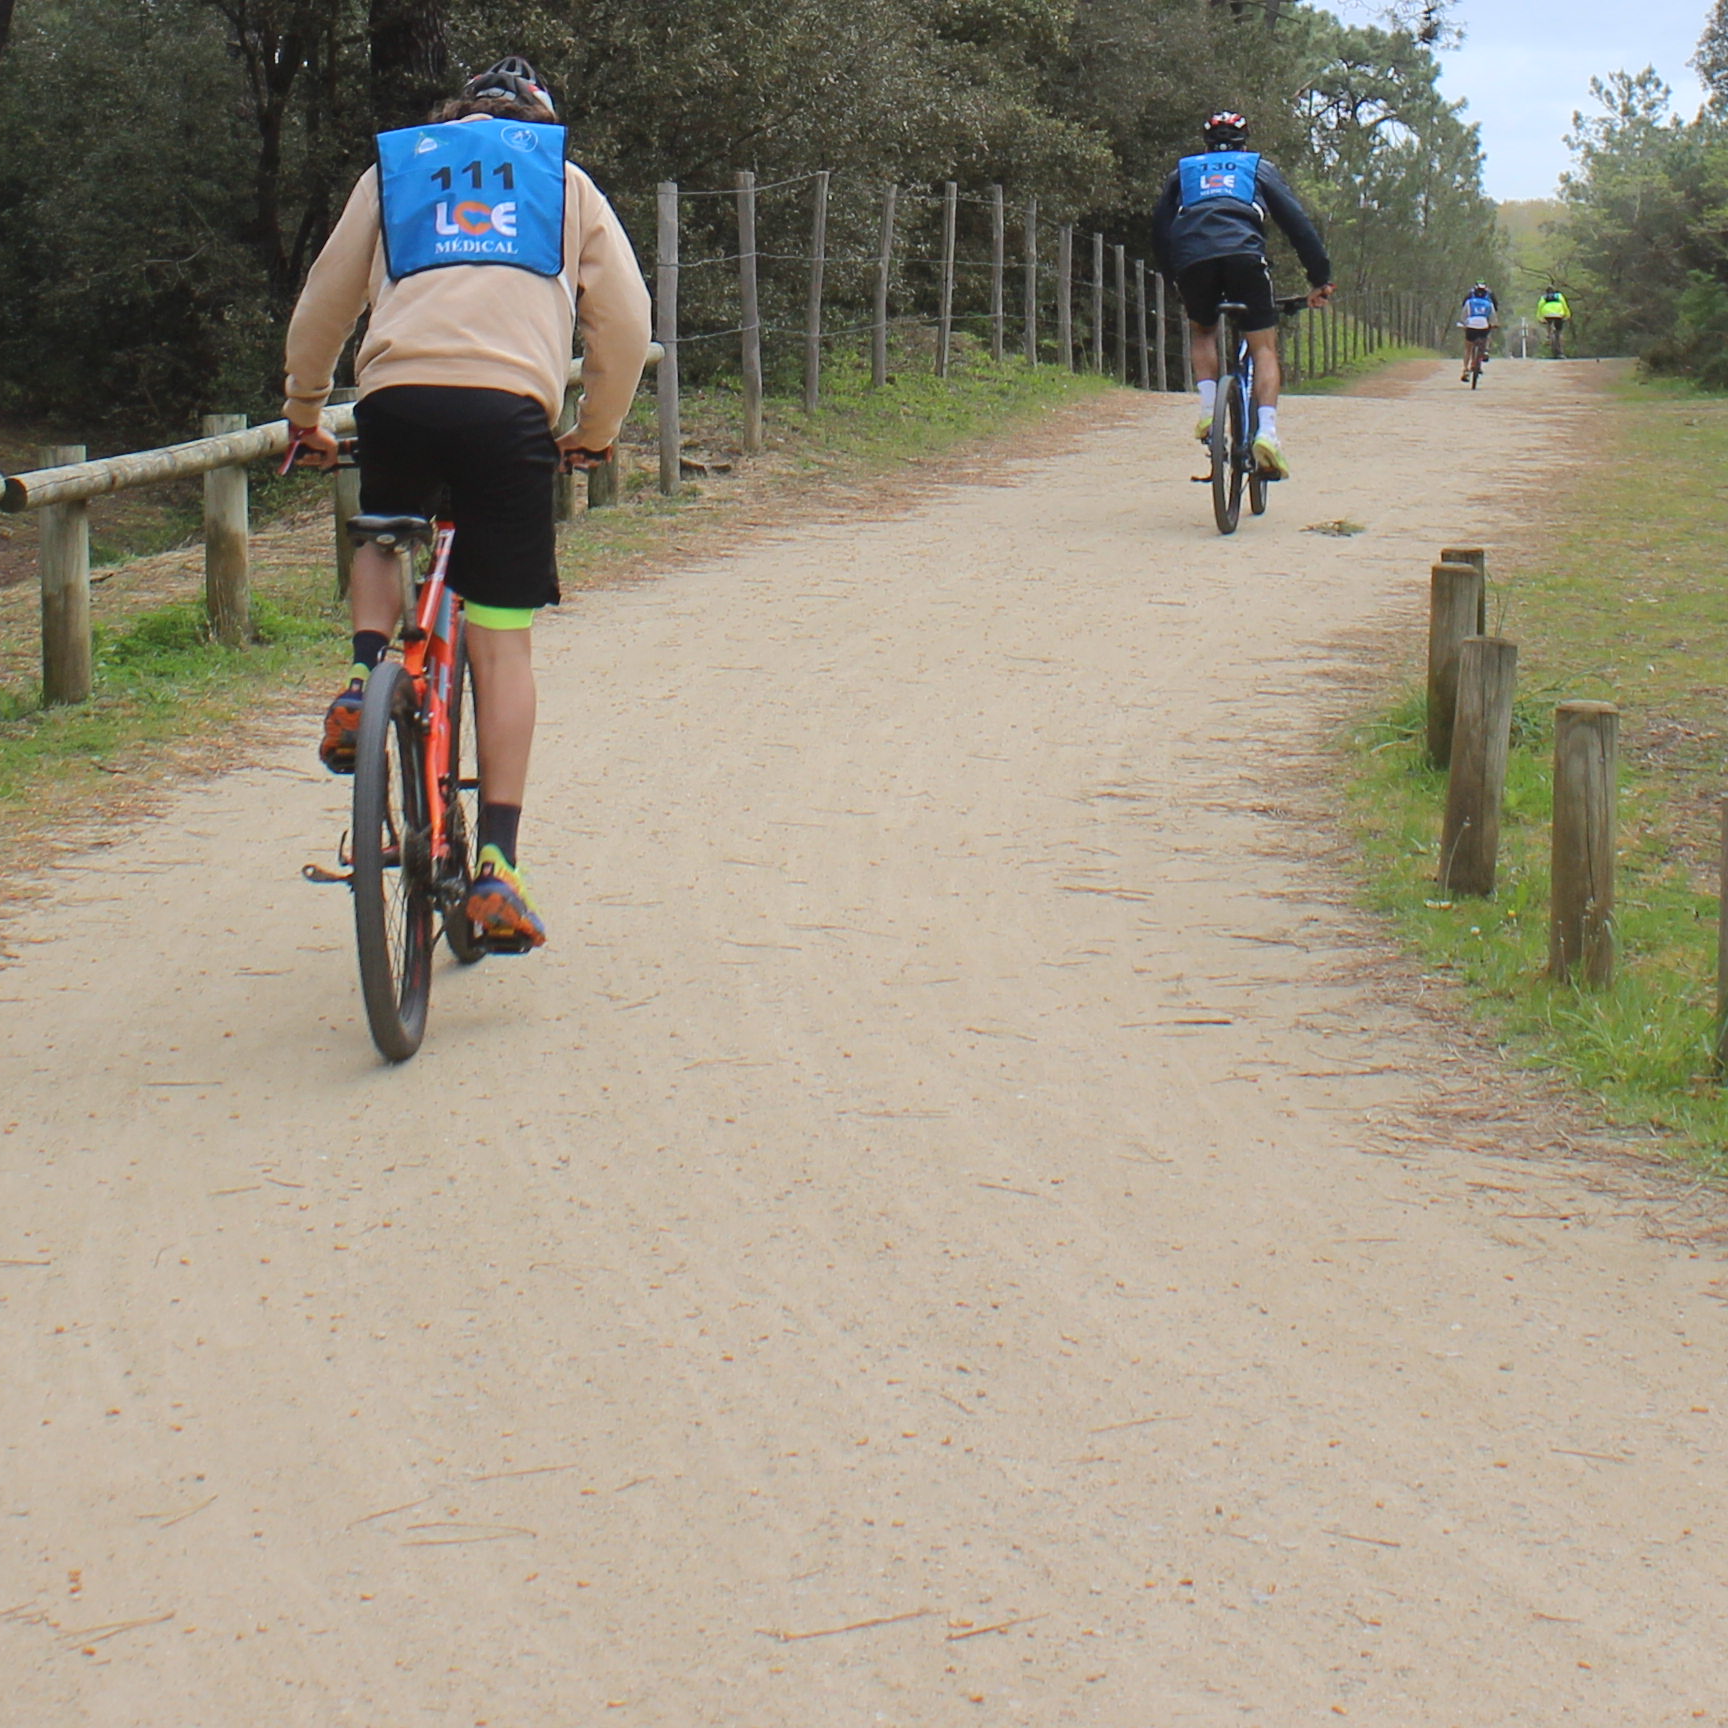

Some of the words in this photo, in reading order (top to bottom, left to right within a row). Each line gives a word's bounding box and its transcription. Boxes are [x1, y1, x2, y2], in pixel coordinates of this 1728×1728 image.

[431, 160, 514, 191] 111
[1200, 162, 1236, 171] 130
[1200, 174, 1235, 189] LCE
[435, 200, 518, 237] LCE
[434, 236, 519, 255] MÉDICAL
